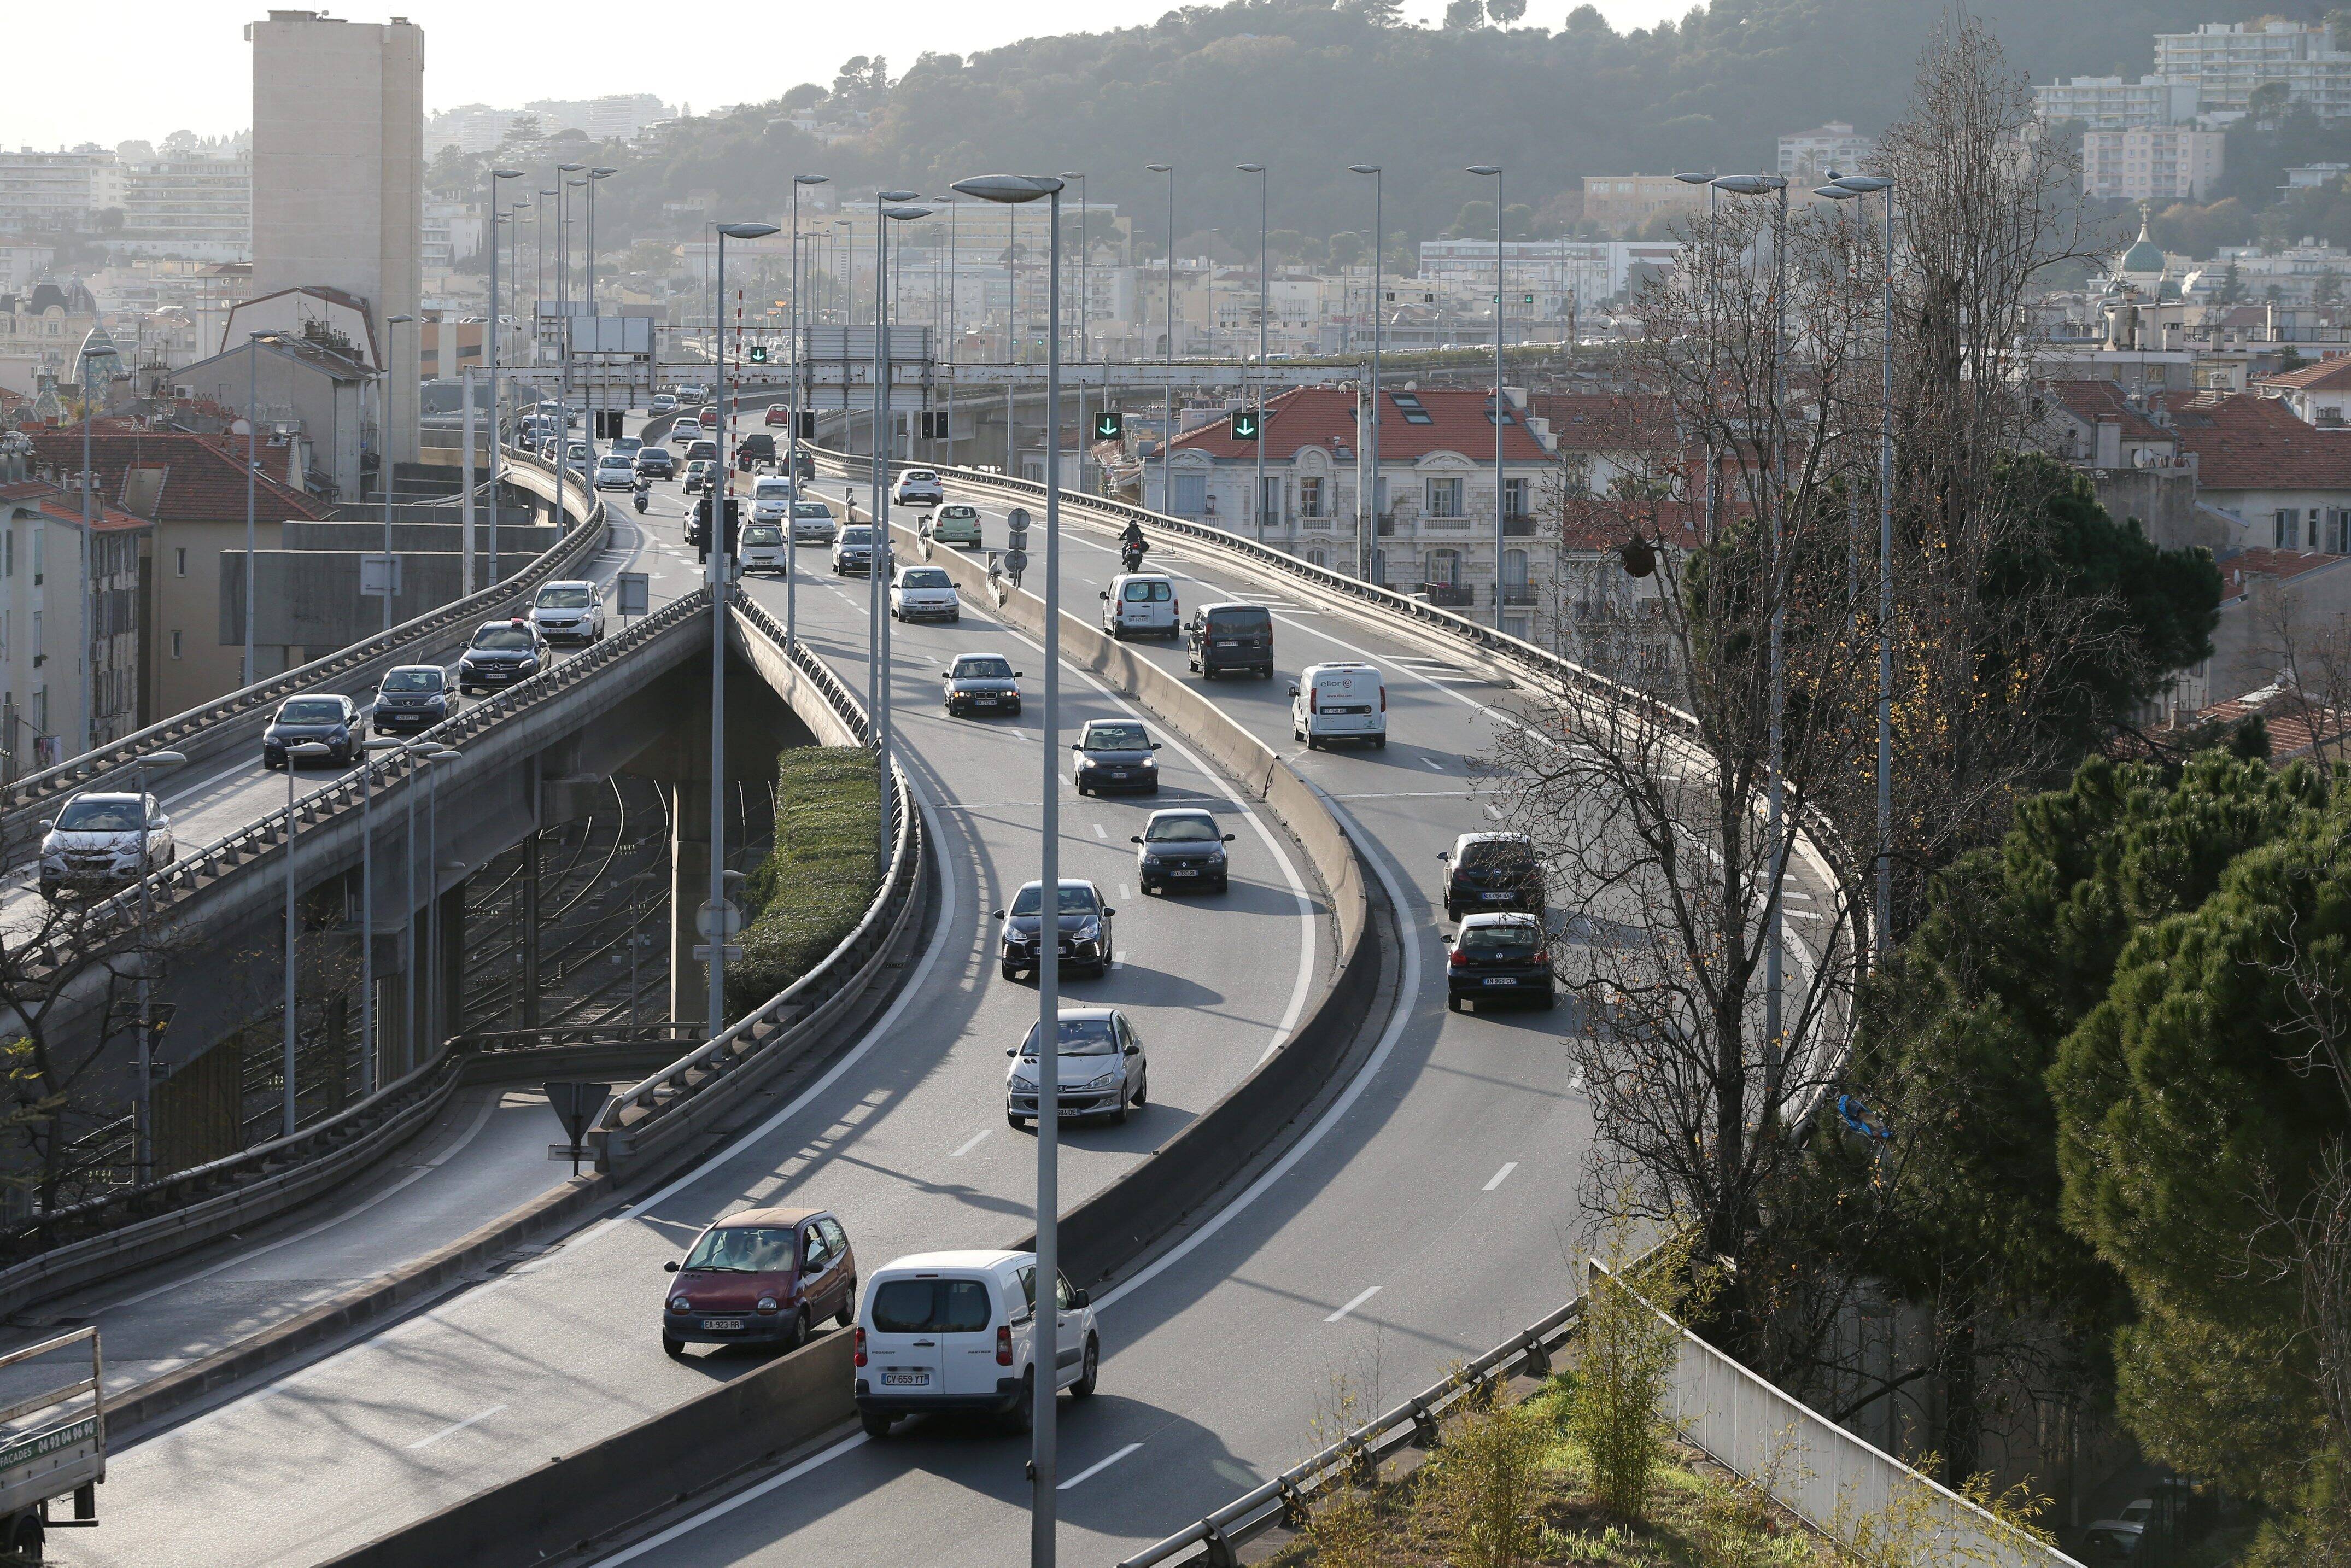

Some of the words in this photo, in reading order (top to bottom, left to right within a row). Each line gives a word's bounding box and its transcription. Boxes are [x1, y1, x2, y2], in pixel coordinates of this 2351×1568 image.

[0, 1447, 32, 1467] FAÇADES
[38, 1439, 48, 1453] 04
[50, 1435, 60, 1449] 92
[61, 1430, 71, 1444] 04
[73, 1426, 82, 1440] 96
[84, 1421, 94, 1436] 90
